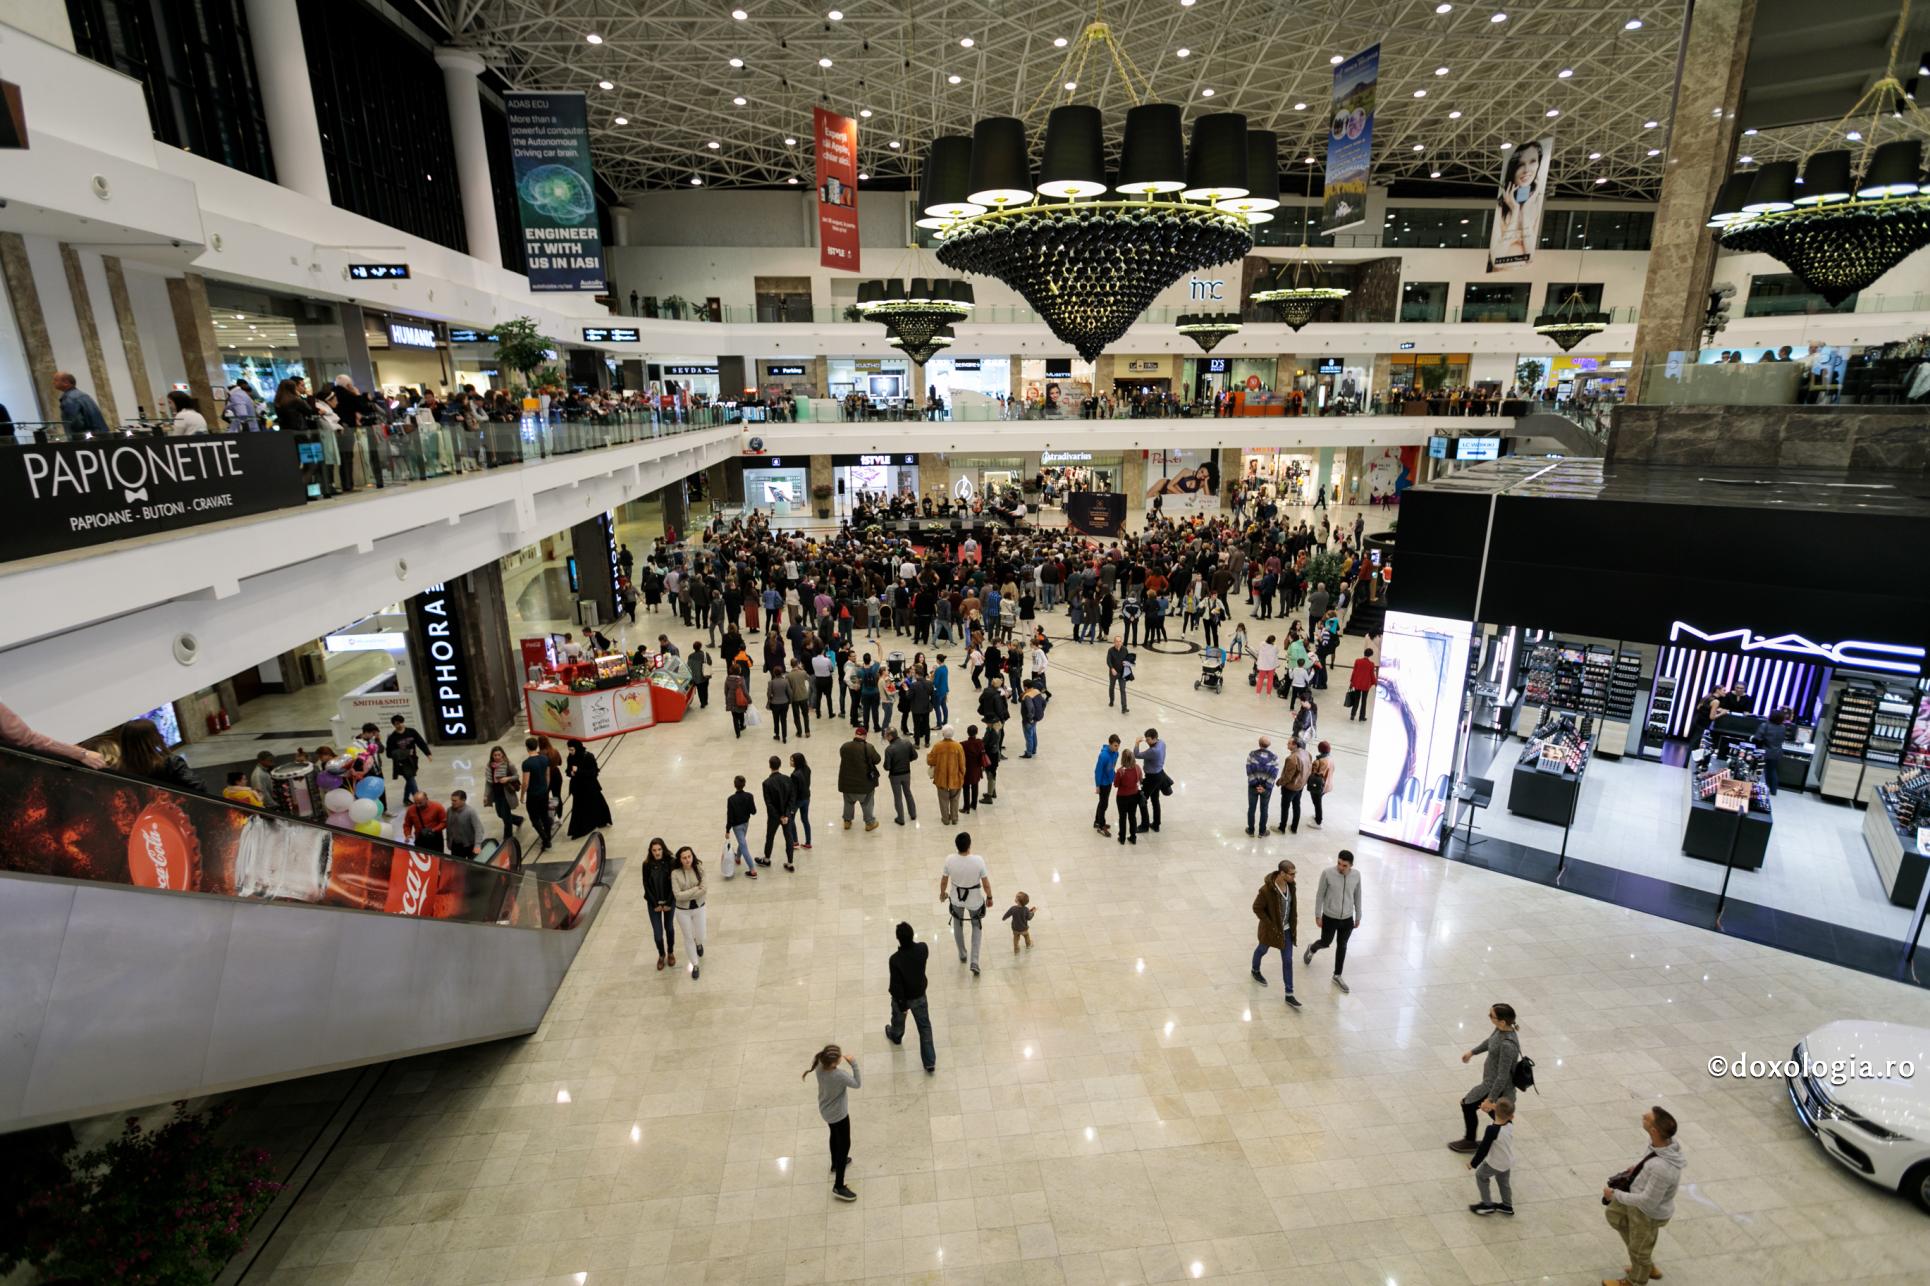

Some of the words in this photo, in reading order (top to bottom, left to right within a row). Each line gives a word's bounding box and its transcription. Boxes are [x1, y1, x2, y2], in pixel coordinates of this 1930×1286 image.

[508, 100, 531, 108] ADAS
[532, 100, 549, 108] ECU
[510, 115, 531, 123] More
[532, 115, 550, 123] than
[512, 127, 545, 136] powerful
[527, 138, 578, 146] Autonomous
[515, 149, 542, 158] Driving
[525, 228, 598, 240] ENGINEER
[527, 243, 541, 254] IT
[543, 243, 582, 254] WITH
[529, 257, 549, 269] US
[552, 257, 568, 269] IN
[571, 257, 600, 269] IASI
[391, 324, 436, 348] HUMANIC
[23, 440, 244, 499] PAPIONETTE
[70, 510, 133, 531] PAPIOANE
[143, 500, 185, 520] BUTONI
[194, 493, 233, 512] CRAVATE
[608, 524, 623, 613] SEPHORA
[424, 599, 467, 735] SEPHORA
[353, 697, 409, 707] SMITH&SMITH
